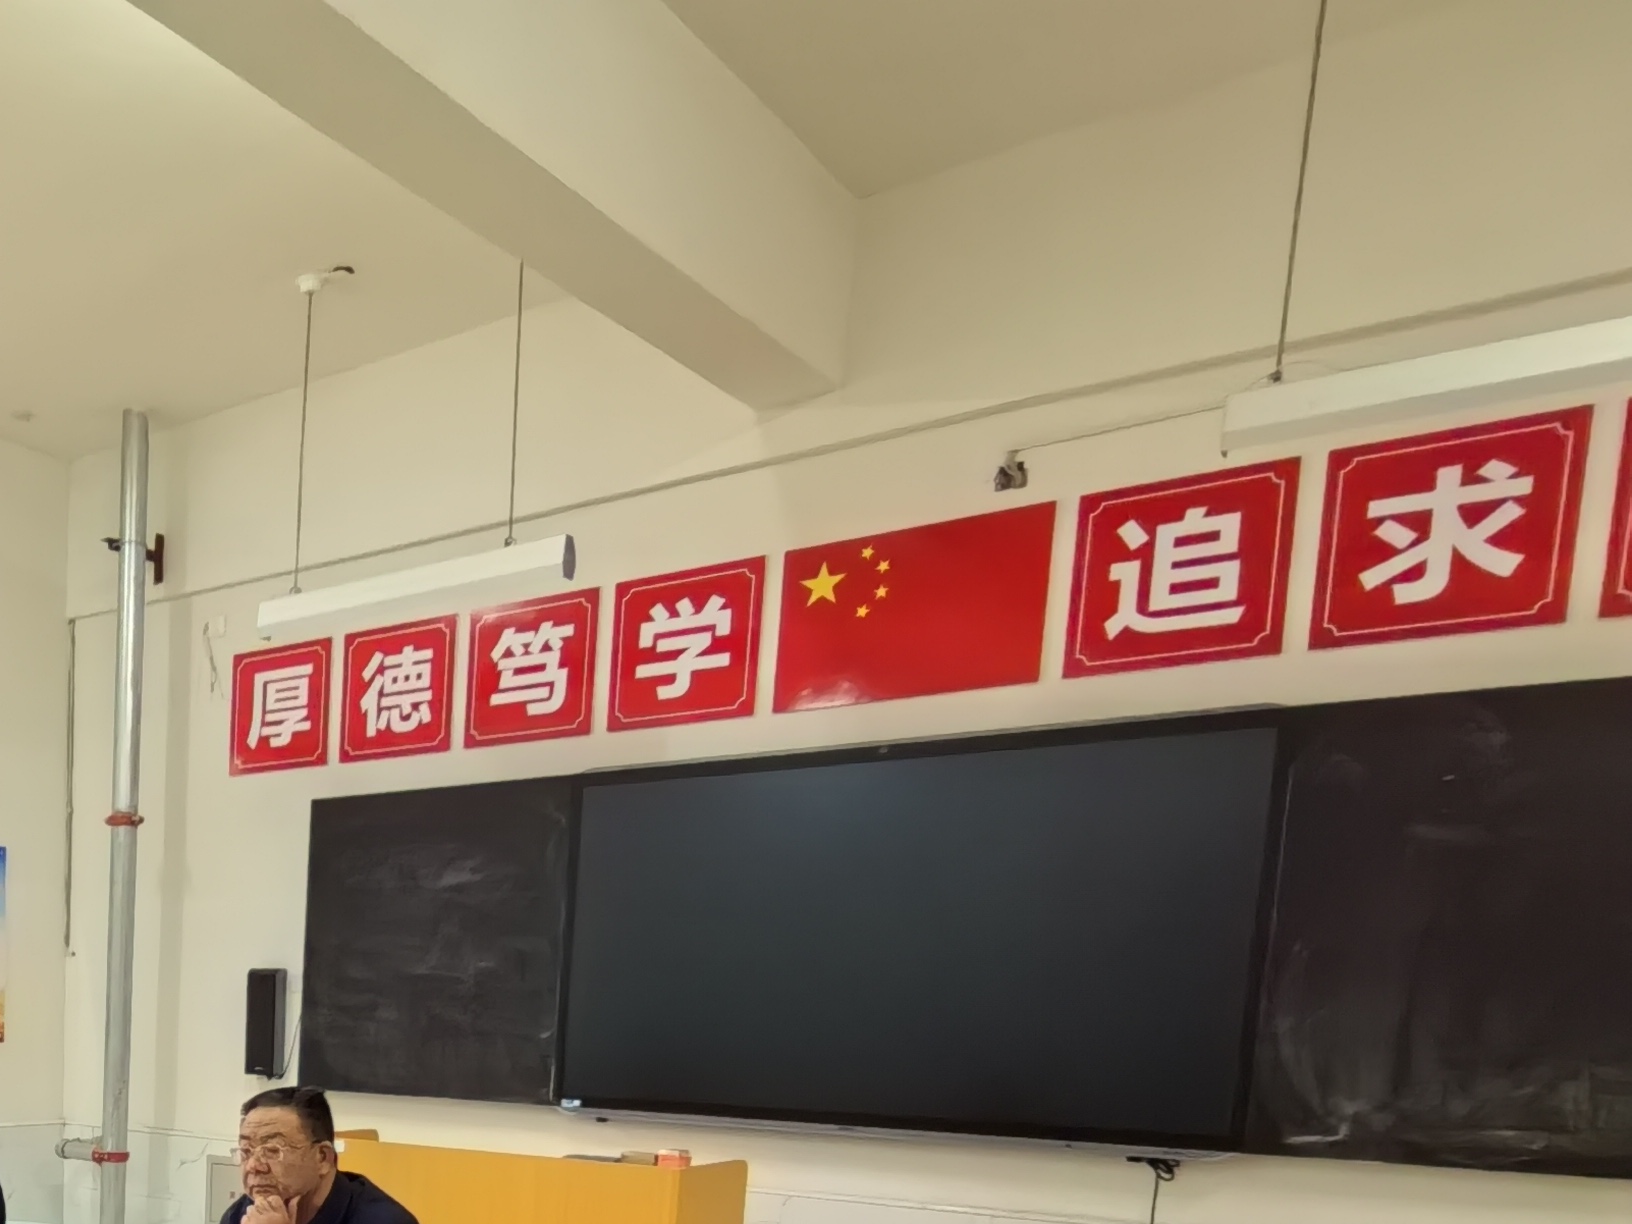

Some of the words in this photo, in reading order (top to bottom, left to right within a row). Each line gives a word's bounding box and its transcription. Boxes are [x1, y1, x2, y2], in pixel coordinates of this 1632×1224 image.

[246, 594, 733, 750] 厚德笃学
[1103, 459, 1535, 642] 追求
